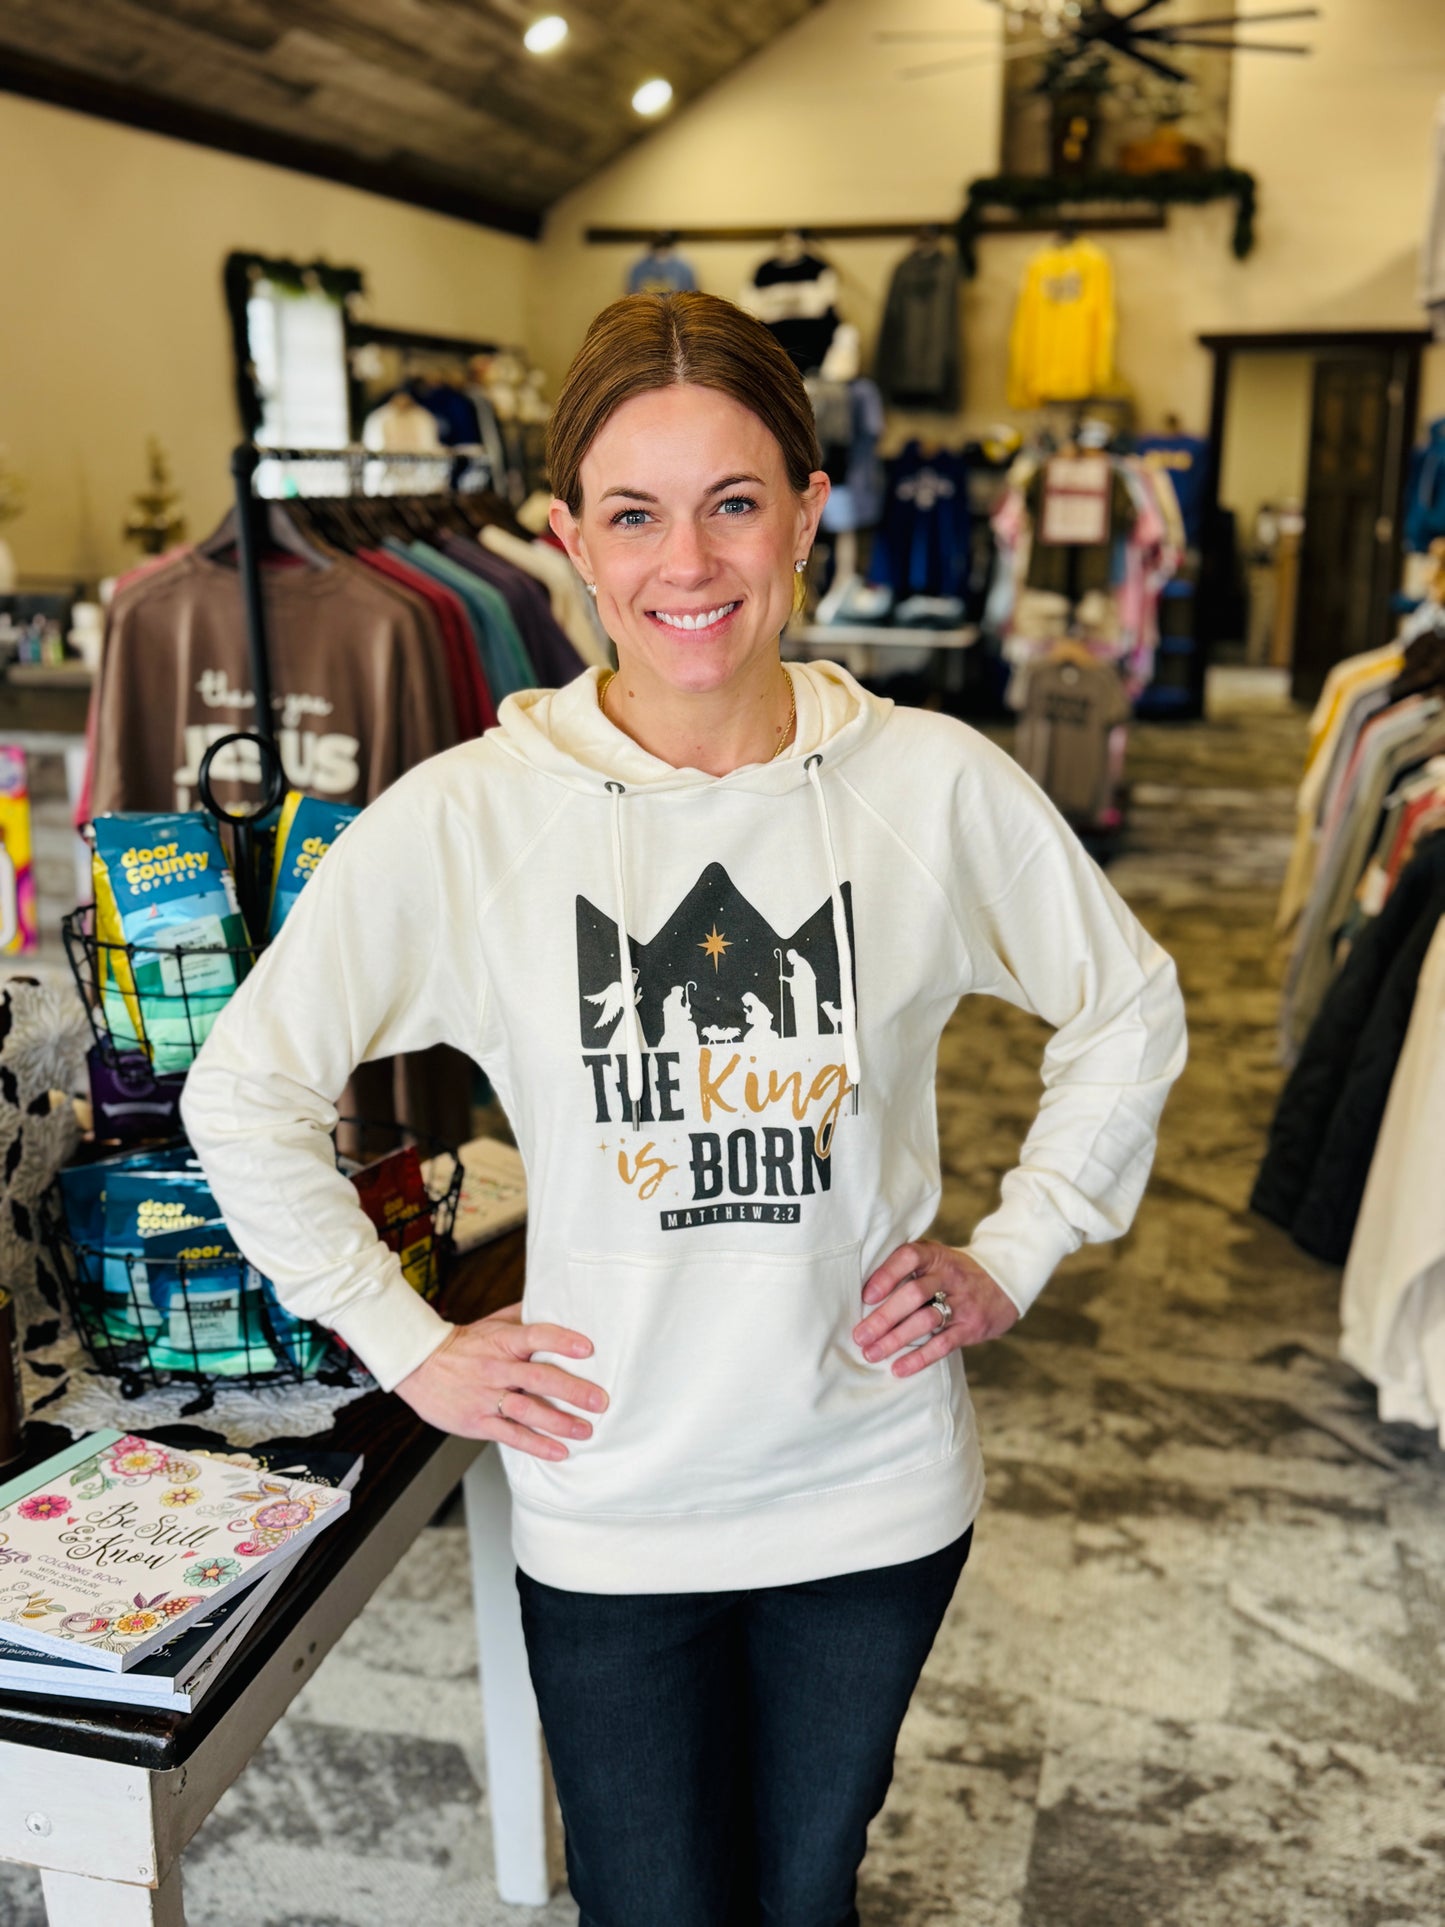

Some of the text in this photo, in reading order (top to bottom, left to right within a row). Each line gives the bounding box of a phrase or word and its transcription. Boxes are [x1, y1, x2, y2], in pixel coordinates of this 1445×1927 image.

[121, 842, 179, 869] door
[125, 851, 209, 885] county
[130, 870, 197, 896] COFFEE
[581, 1047, 854, 1160] THE King
[617, 1123, 832, 1201] is BORN
[137, 1199, 186, 1217] door
[667, 1205, 795, 1228] MATTHEW 2:2
[85, 1501, 220, 1548] Be Still
[58, 1525, 178, 1570] & Know
[20, 1568, 103, 1598] VERSES FROM PSALMS
[38, 1554, 127, 1586] COLORING BOOK
[39, 1566, 101, 1590] WITH SCRIPTURE
[7, 1648, 46, 1658] purpose
